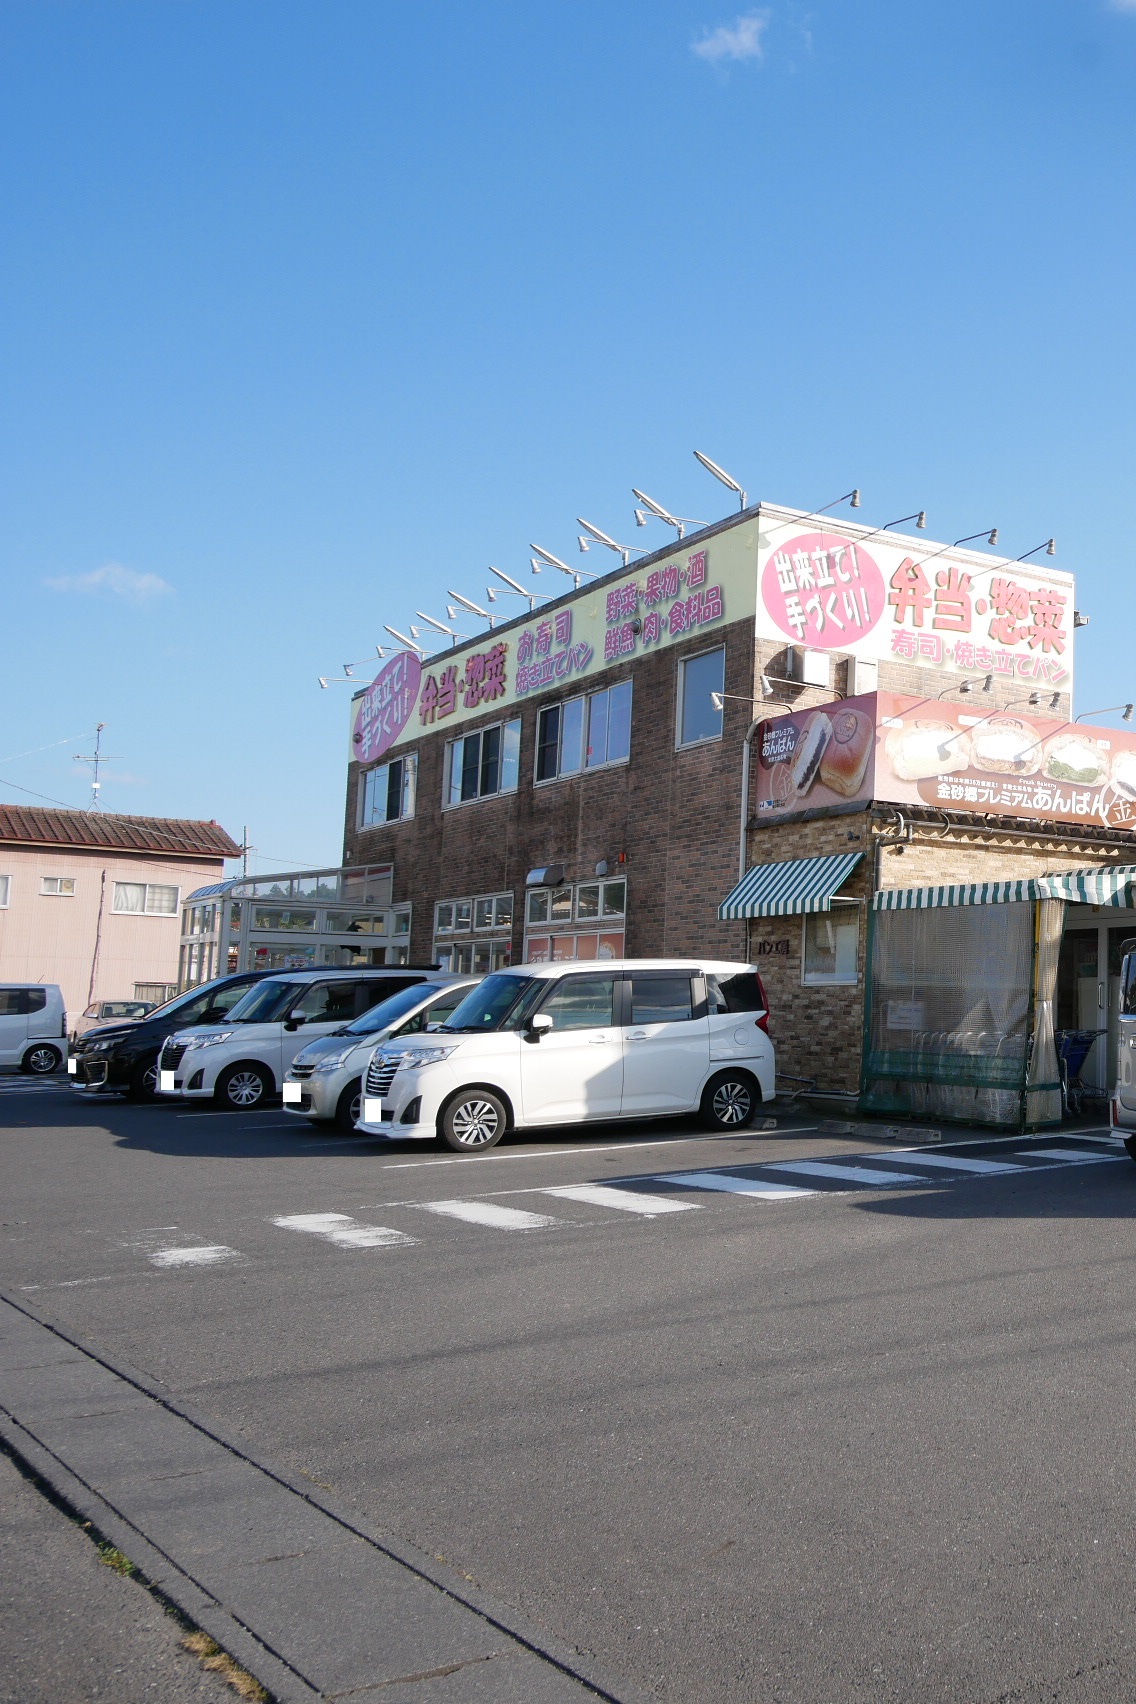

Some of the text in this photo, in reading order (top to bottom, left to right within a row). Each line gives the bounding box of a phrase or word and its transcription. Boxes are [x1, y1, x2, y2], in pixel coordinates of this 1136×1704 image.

[606, 549, 706, 622] 野菜・果物・酒
[774, 543, 859, 593] 出来立て!
[516, 609, 572, 664] お寿司
[604, 585, 722, 660] 鮮魚肉・食料品
[784, 587, 870, 638] 手づくり!
[888, 556, 1068, 655] 弁当・惣菜
[361, 653, 408, 729] 出来立て!
[418, 641, 507, 726] 弁当・惣菜
[514, 641, 593, 695] 焼き立てパン
[890, 628, 1068, 682] 寿司・焼き立てパン
[361, 687, 408, 760] 手づくり!
